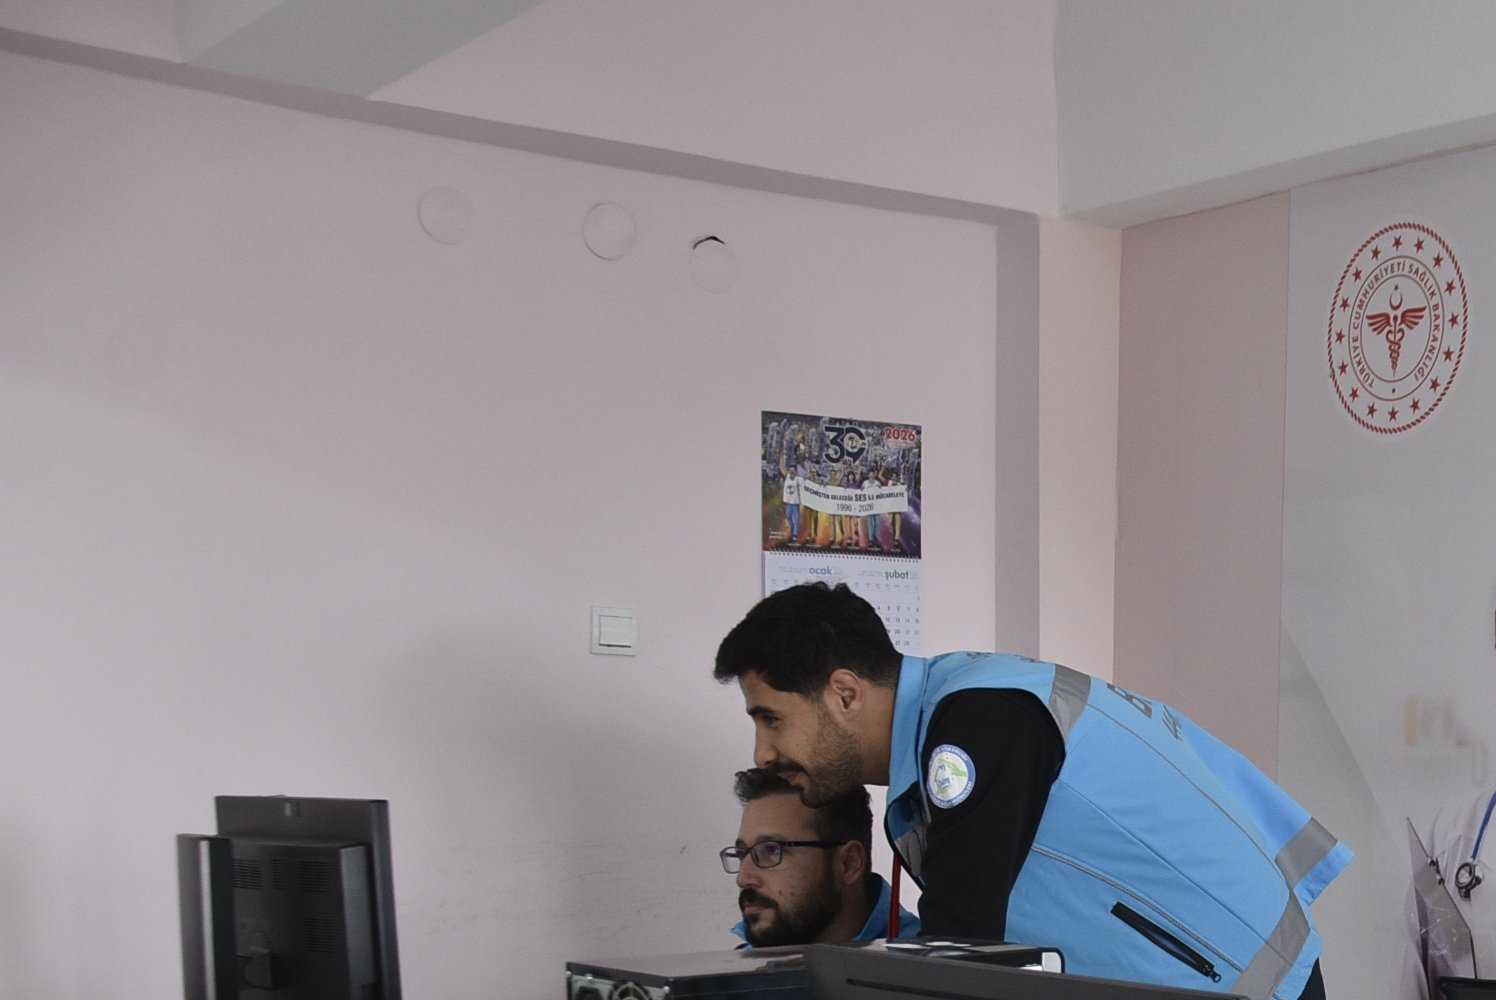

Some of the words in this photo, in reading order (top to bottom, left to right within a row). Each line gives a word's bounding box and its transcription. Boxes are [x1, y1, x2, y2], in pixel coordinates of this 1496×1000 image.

[1408, 263, 1437, 300] SAĞLIK
[1353, 260, 1406, 330] CUMHURİYETİ
[1414, 303, 1441, 381] BAKANLIĞI
[1352, 335, 1375, 388] TÜRKİYE
[885, 427, 916, 442] 2026
[854, 493, 867, 502] SES
[837, 503, 853, 513] 1996
[858, 503, 874, 513] 2026
[809, 565, 832, 575] ocak
[885, 569, 909, 581] şubat
